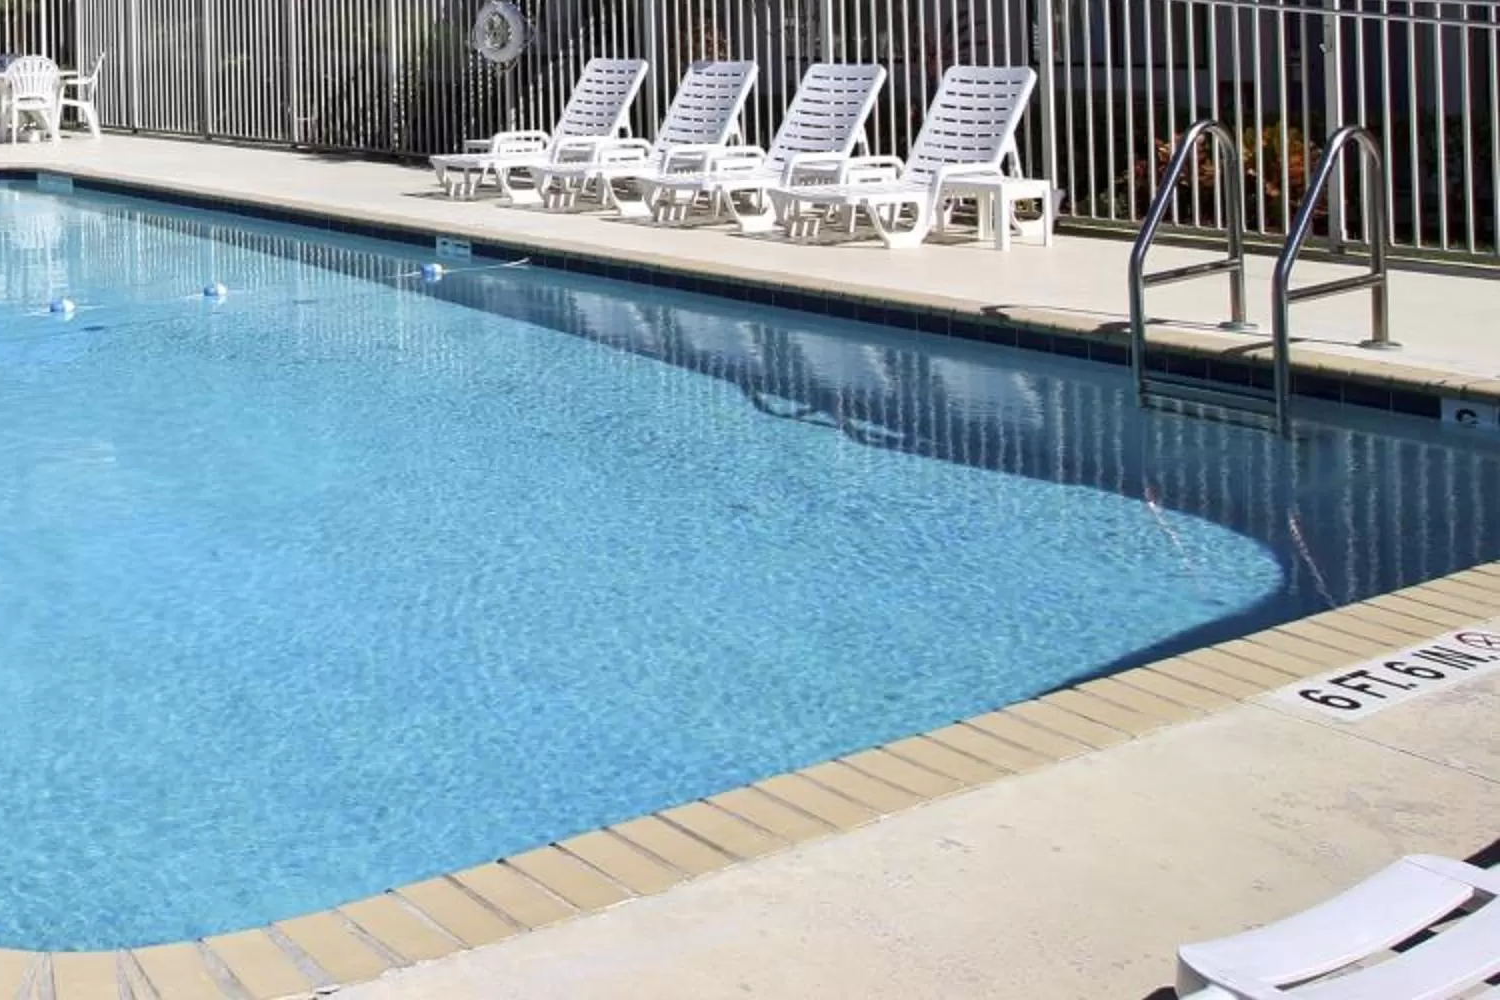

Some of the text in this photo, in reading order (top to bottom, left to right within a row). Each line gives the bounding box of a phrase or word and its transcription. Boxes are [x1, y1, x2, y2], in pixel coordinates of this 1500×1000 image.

[1298, 644, 1499, 711] 6 FT. 6 IN.
